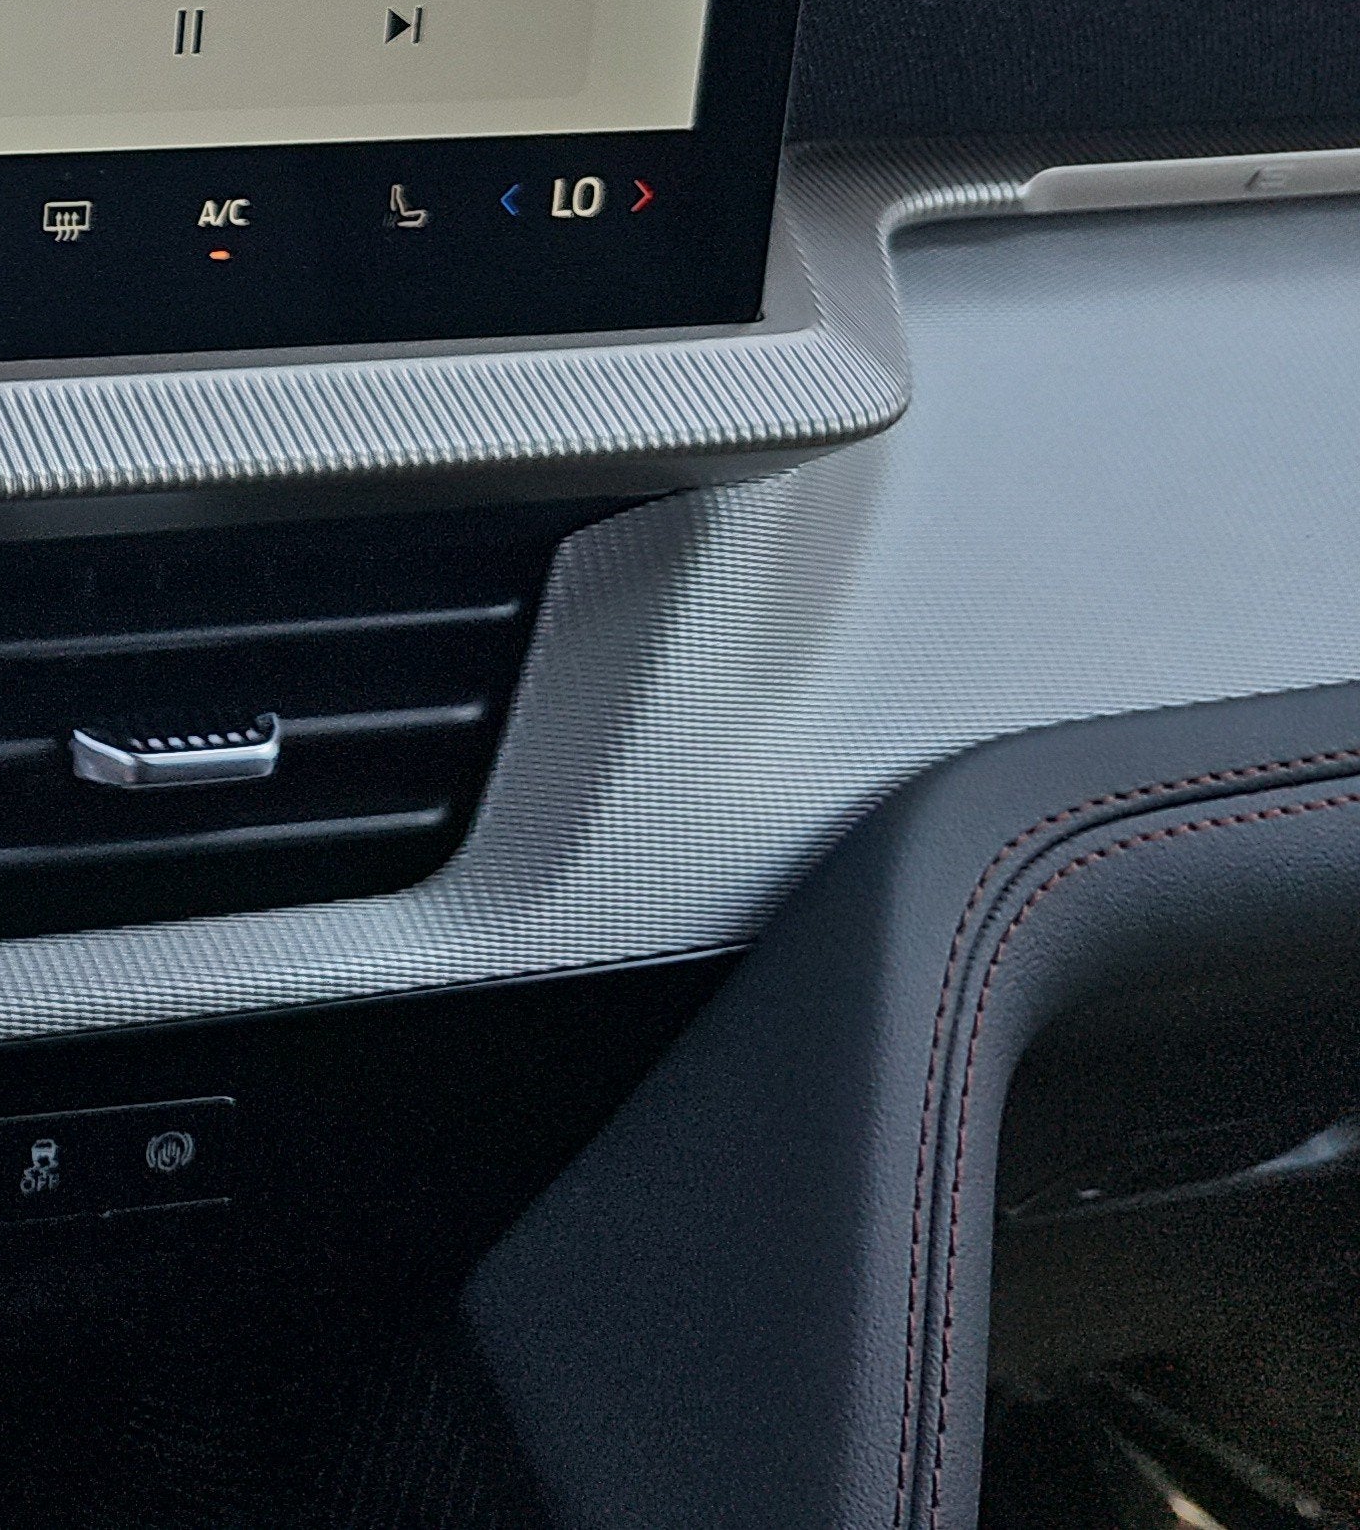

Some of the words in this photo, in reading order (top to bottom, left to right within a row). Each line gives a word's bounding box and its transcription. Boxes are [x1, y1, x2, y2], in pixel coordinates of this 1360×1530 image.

[551, 176, 607, 218] LO
[197, 198, 252, 227] A/C
[20, 1172, 60, 1194] OFF
